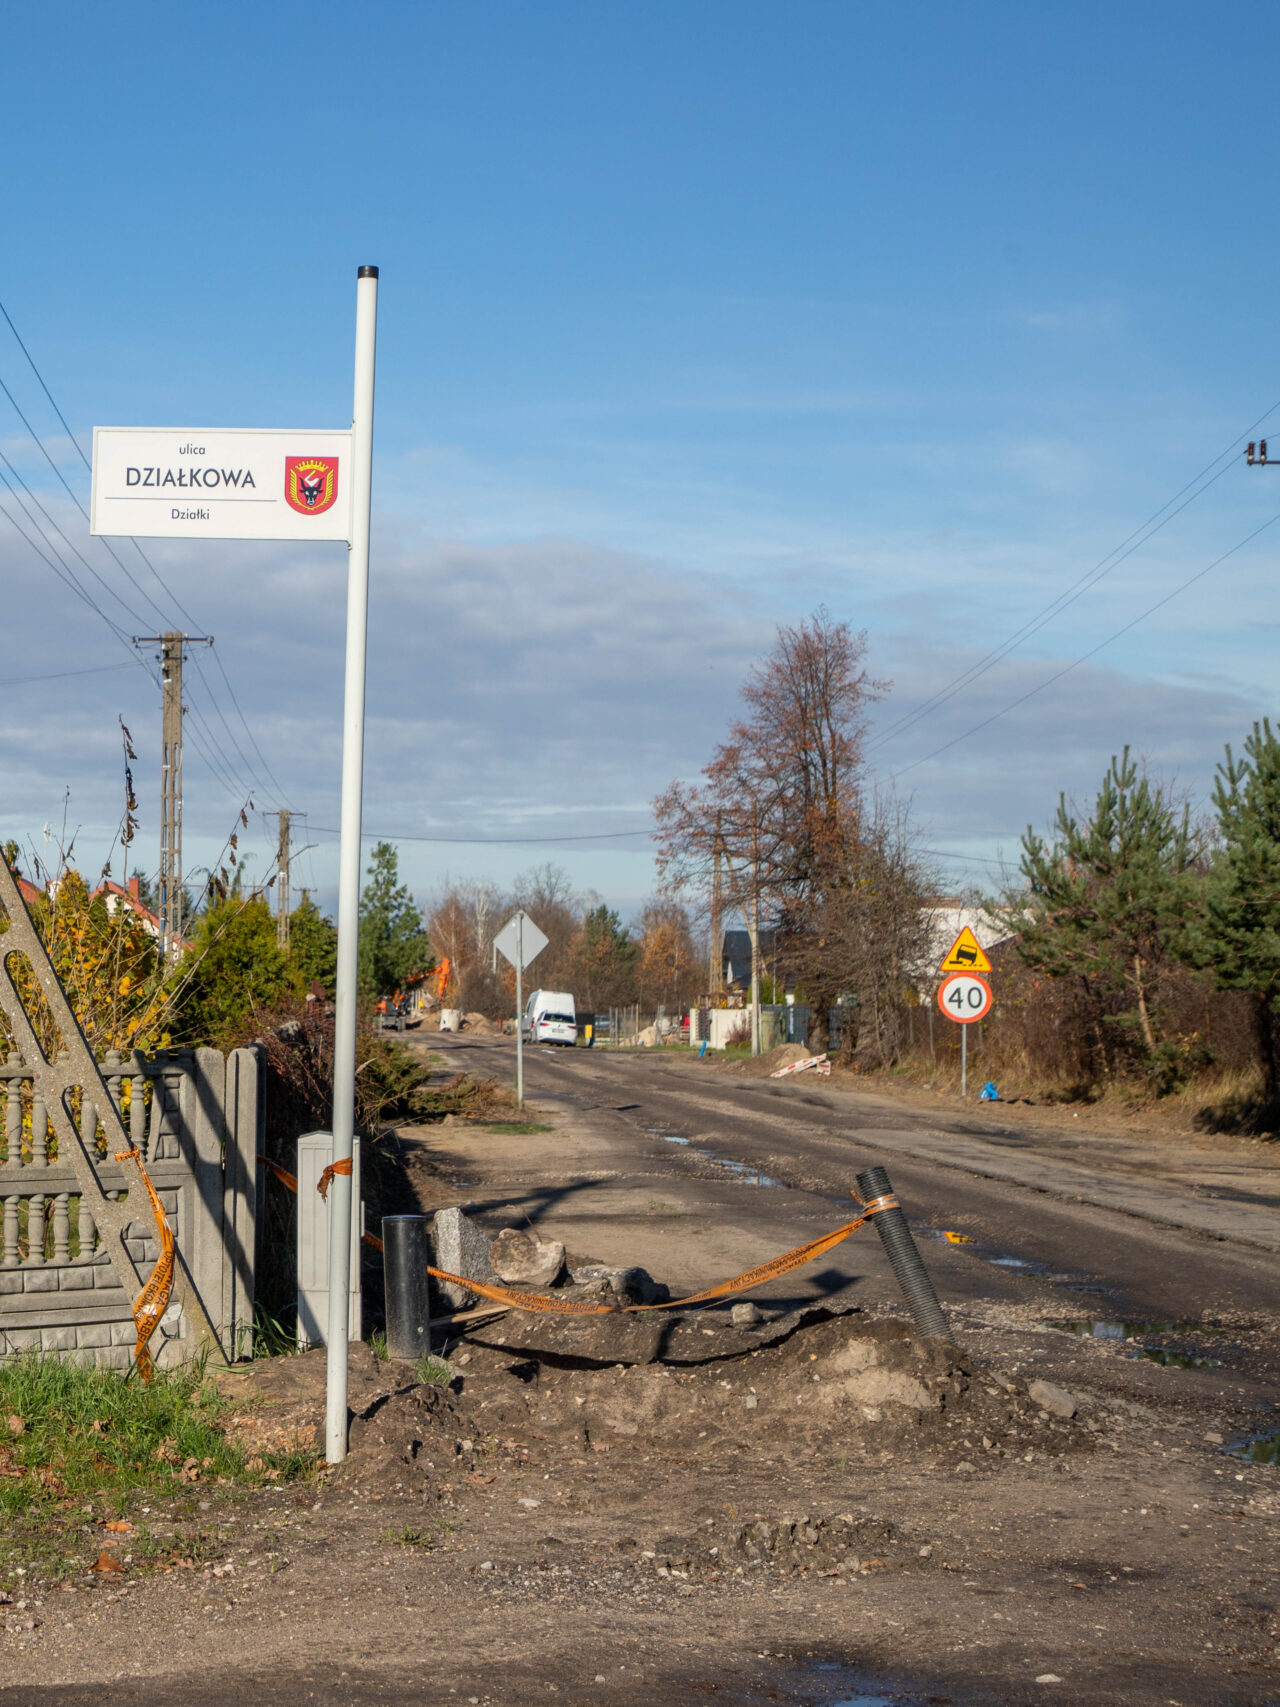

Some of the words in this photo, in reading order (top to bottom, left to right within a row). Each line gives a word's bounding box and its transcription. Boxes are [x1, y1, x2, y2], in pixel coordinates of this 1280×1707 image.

[179, 443, 206, 455] ulica
[125, 466, 257, 489] DZIAŁKOWA
[171, 508, 210, 520] Działki
[948, 986, 983, 1009] 40
